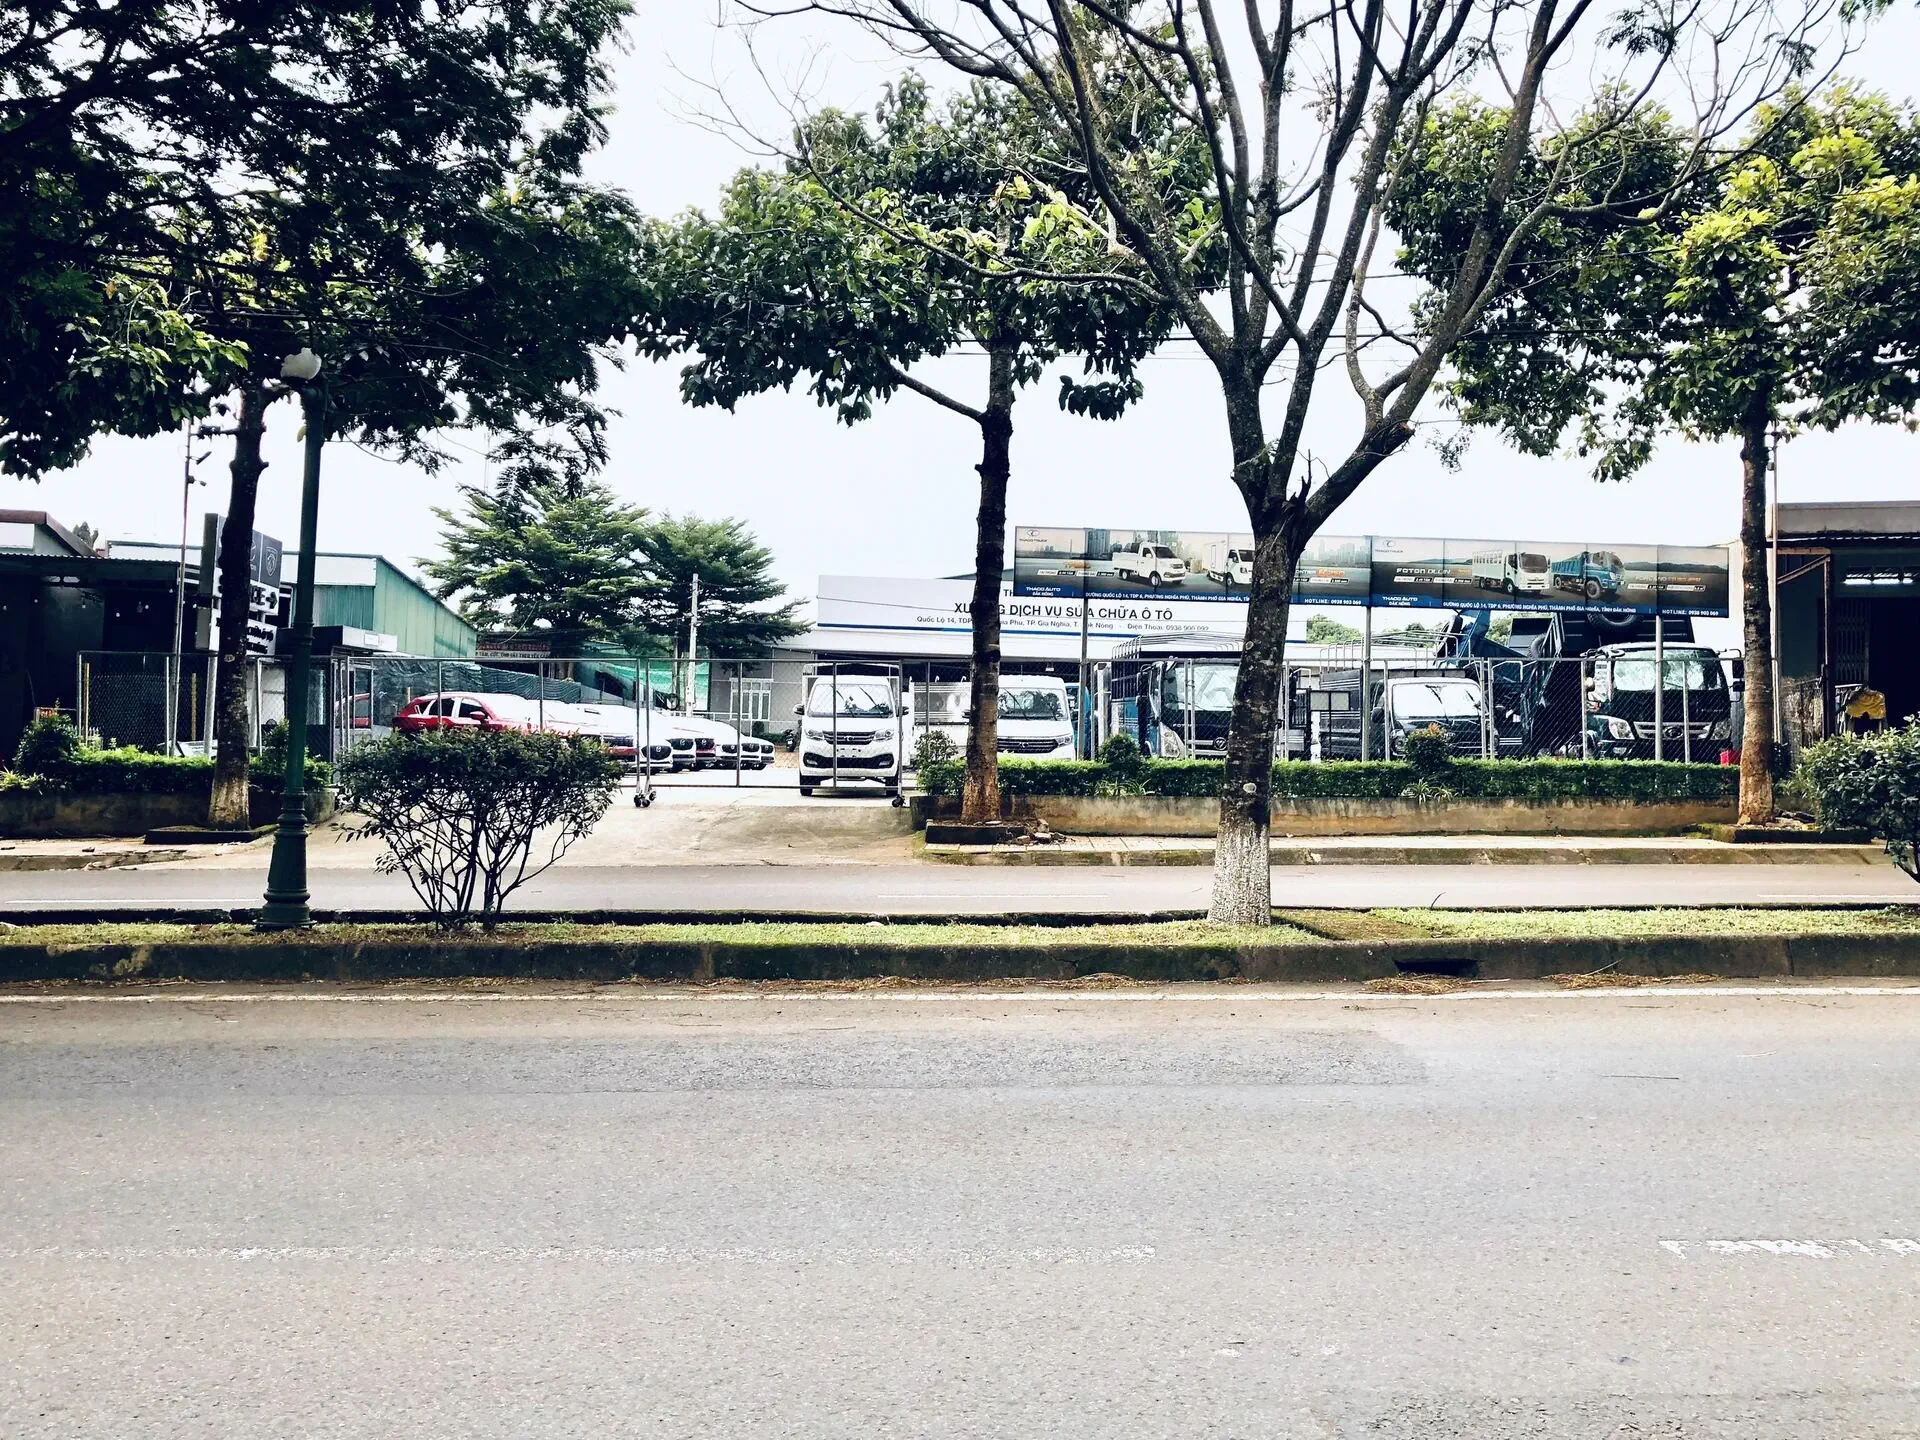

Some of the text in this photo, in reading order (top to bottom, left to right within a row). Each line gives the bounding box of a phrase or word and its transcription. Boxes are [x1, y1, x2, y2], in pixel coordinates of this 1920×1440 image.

[1010, 604, 1041, 617] DỊCH
[1045, 606, 1062, 618] VỤ
[1098, 605, 1138, 619] CHỮA
[1142, 606, 1151, 620] Ô
[1155, 608, 1173, 621] TÔ
[936, 616, 945, 624] Lộ
